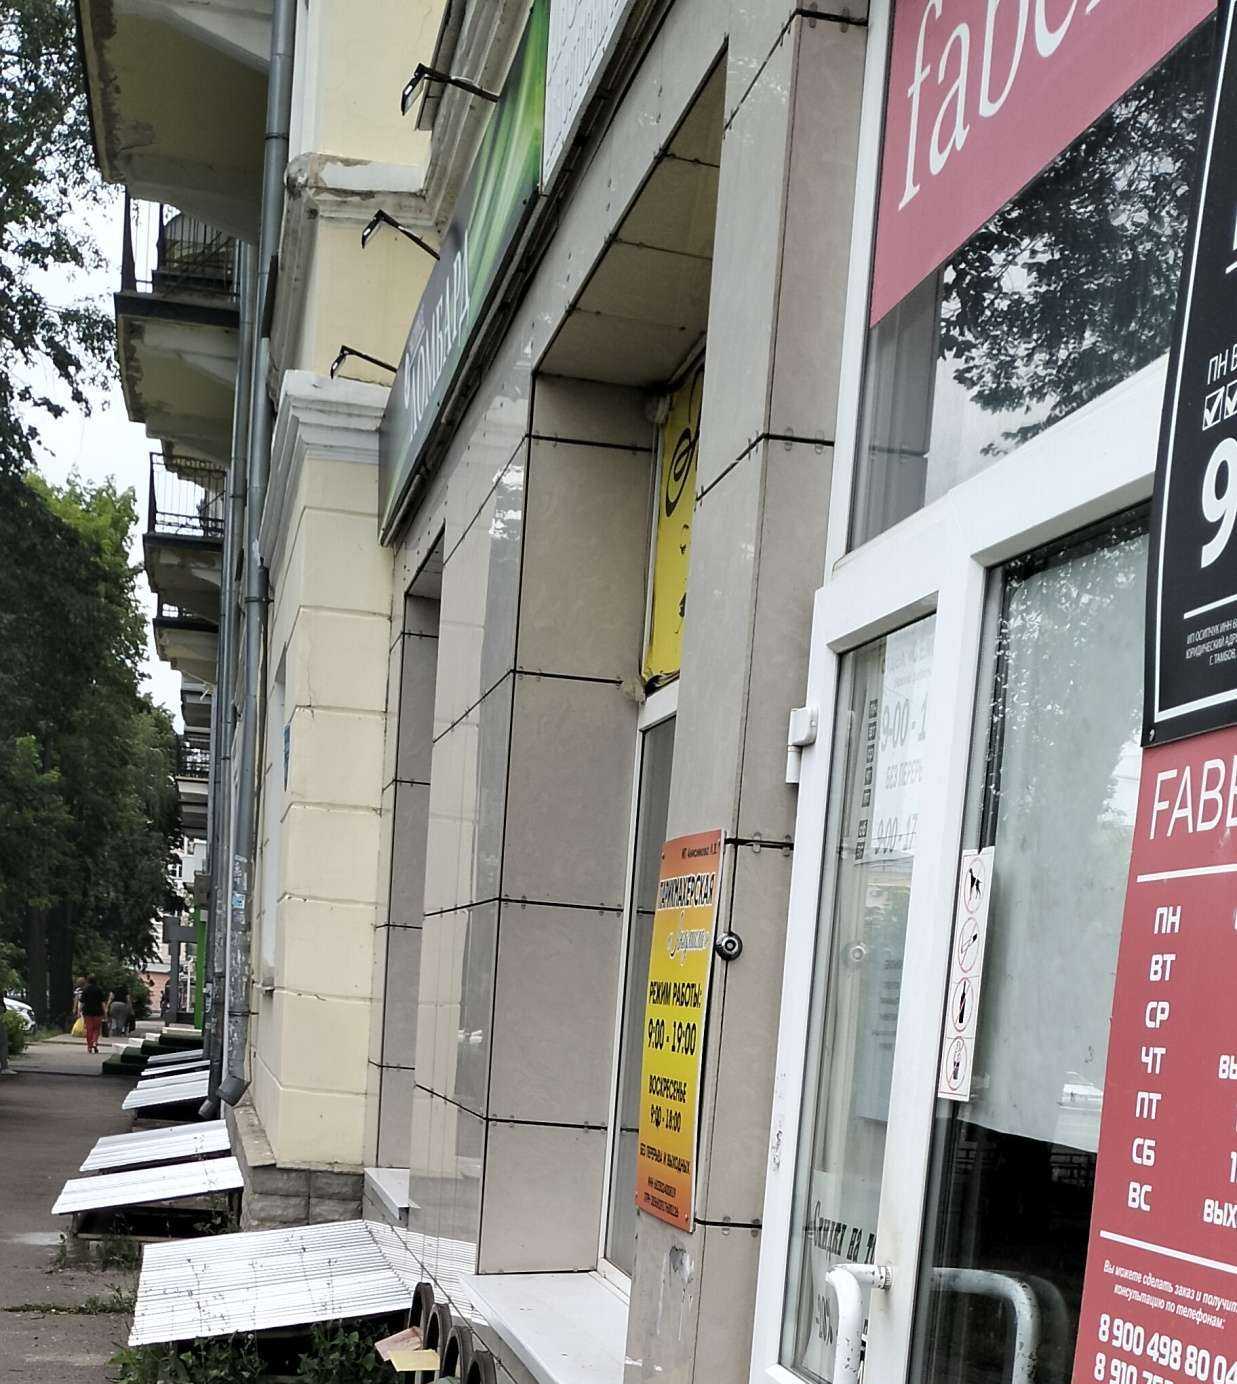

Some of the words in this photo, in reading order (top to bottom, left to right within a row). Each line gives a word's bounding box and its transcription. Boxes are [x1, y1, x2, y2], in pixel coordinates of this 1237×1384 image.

[1207, 349, 1229, 385] ПН
[1154, 905, 1182, 934] ПН
[1149, 954, 1176, 982] ВТ
[649, 981, 671, 1006] РЕЖИМ
[673, 982, 702, 1009] РАБОТЫ:
[1144, 1001, 1170, 1029] СР
[648, 1018, 665, 1050] 9:00
[671, 1021, 697, 1055] 19:00
[1141, 1046, 1167, 1075] ЧТ
[649, 1075, 688, 1103] ВОСКРЕСЕНЬЕ
[1135, 1091, 1162, 1120] ПТ
[1131, 1137, 1156, 1167] СБ
[1127, 1181, 1153, 1212] ВС
[1103, 1259, 1114, 1274] Вы
[1115, 1265, 1142, 1284] можете
[1142, 1272, 1174, 1293] сделать
[1174, 1284, 1195, 1300] заказ
[1195, 1291, 1202, 1302] и
[1113, 1284, 1166, 1309] консультацию
[1165, 1300, 1176, 1313] по
[1175, 1303, 1226, 1329] телефонам:
[1098, 1313, 1111, 1342] 8
[1111, 1318, 1145, 1356] 900
[1146, 1332, 1183, 1371] 498
[1184, 1344, 1211, 1382] 80
[1094, 1352, 1106, 1381] 8
